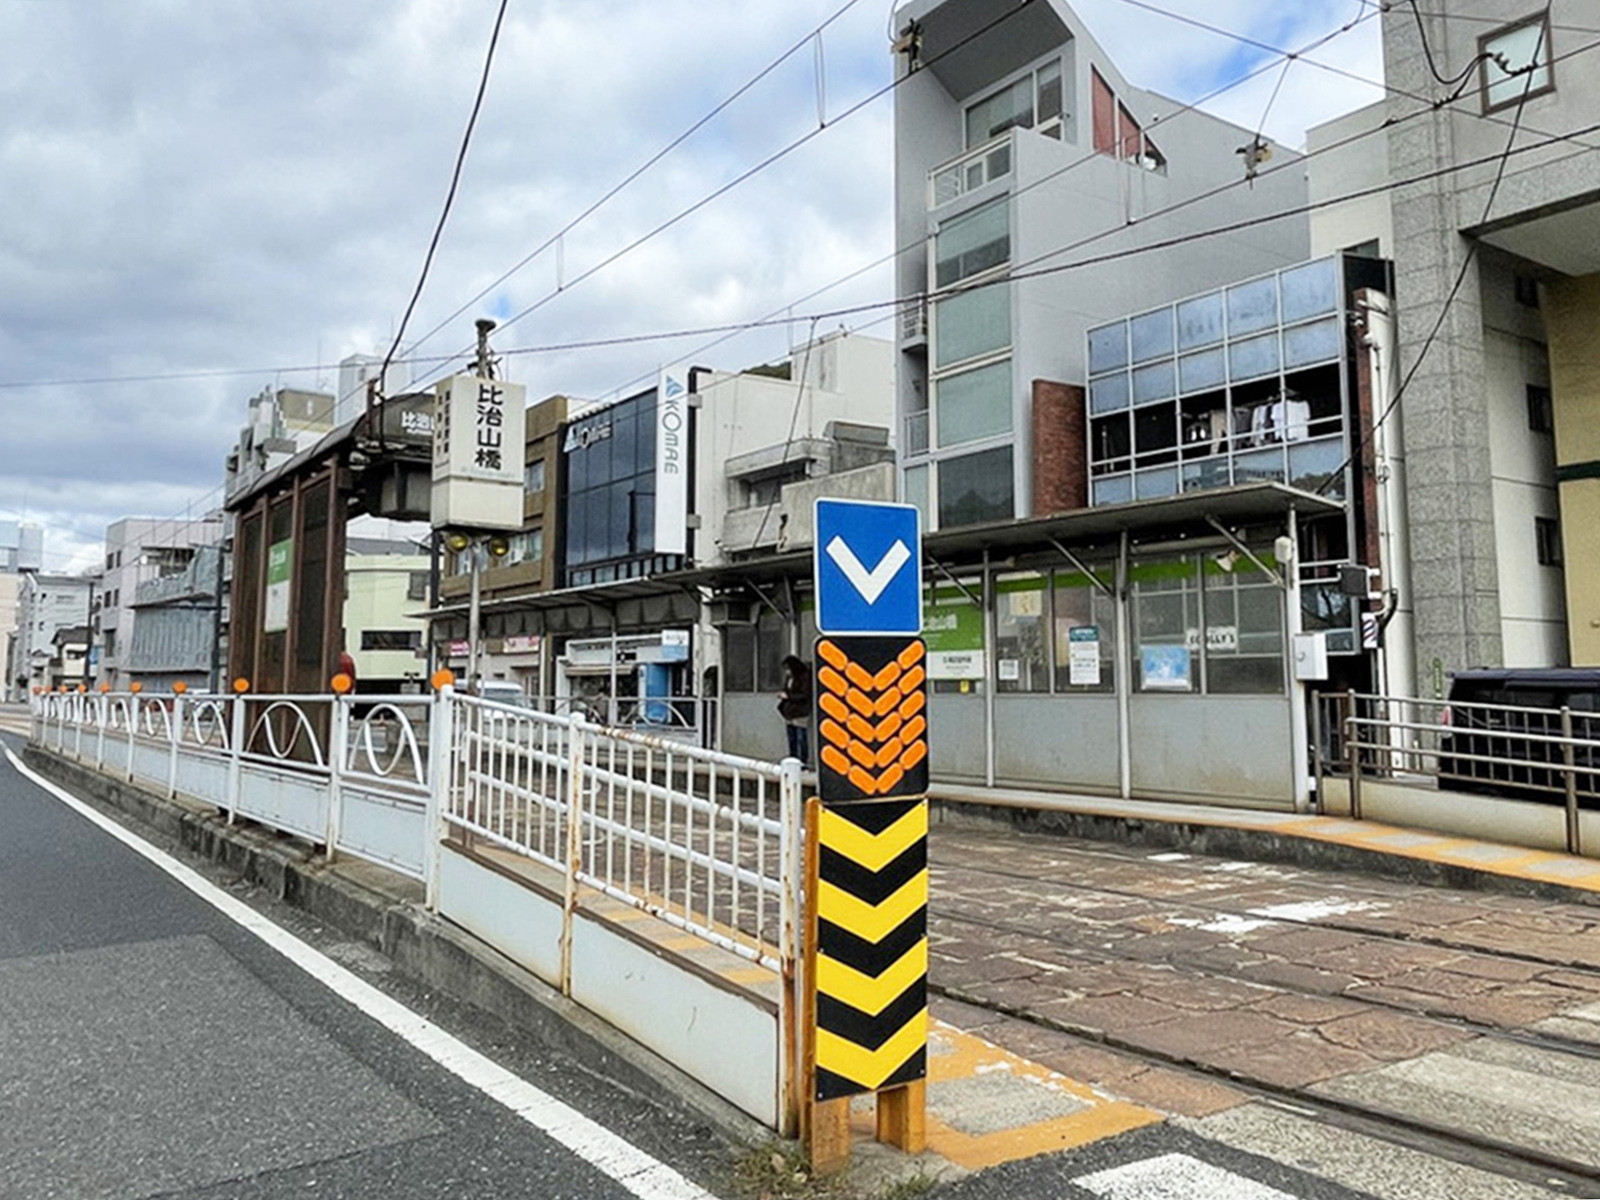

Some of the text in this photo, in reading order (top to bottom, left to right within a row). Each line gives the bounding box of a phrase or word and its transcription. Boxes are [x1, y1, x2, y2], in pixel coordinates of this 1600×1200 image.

[402, 410, 434, 430] 比治
[474, 383, 503, 470] 比治山橋
[662, 400, 682, 474] KOMAE
